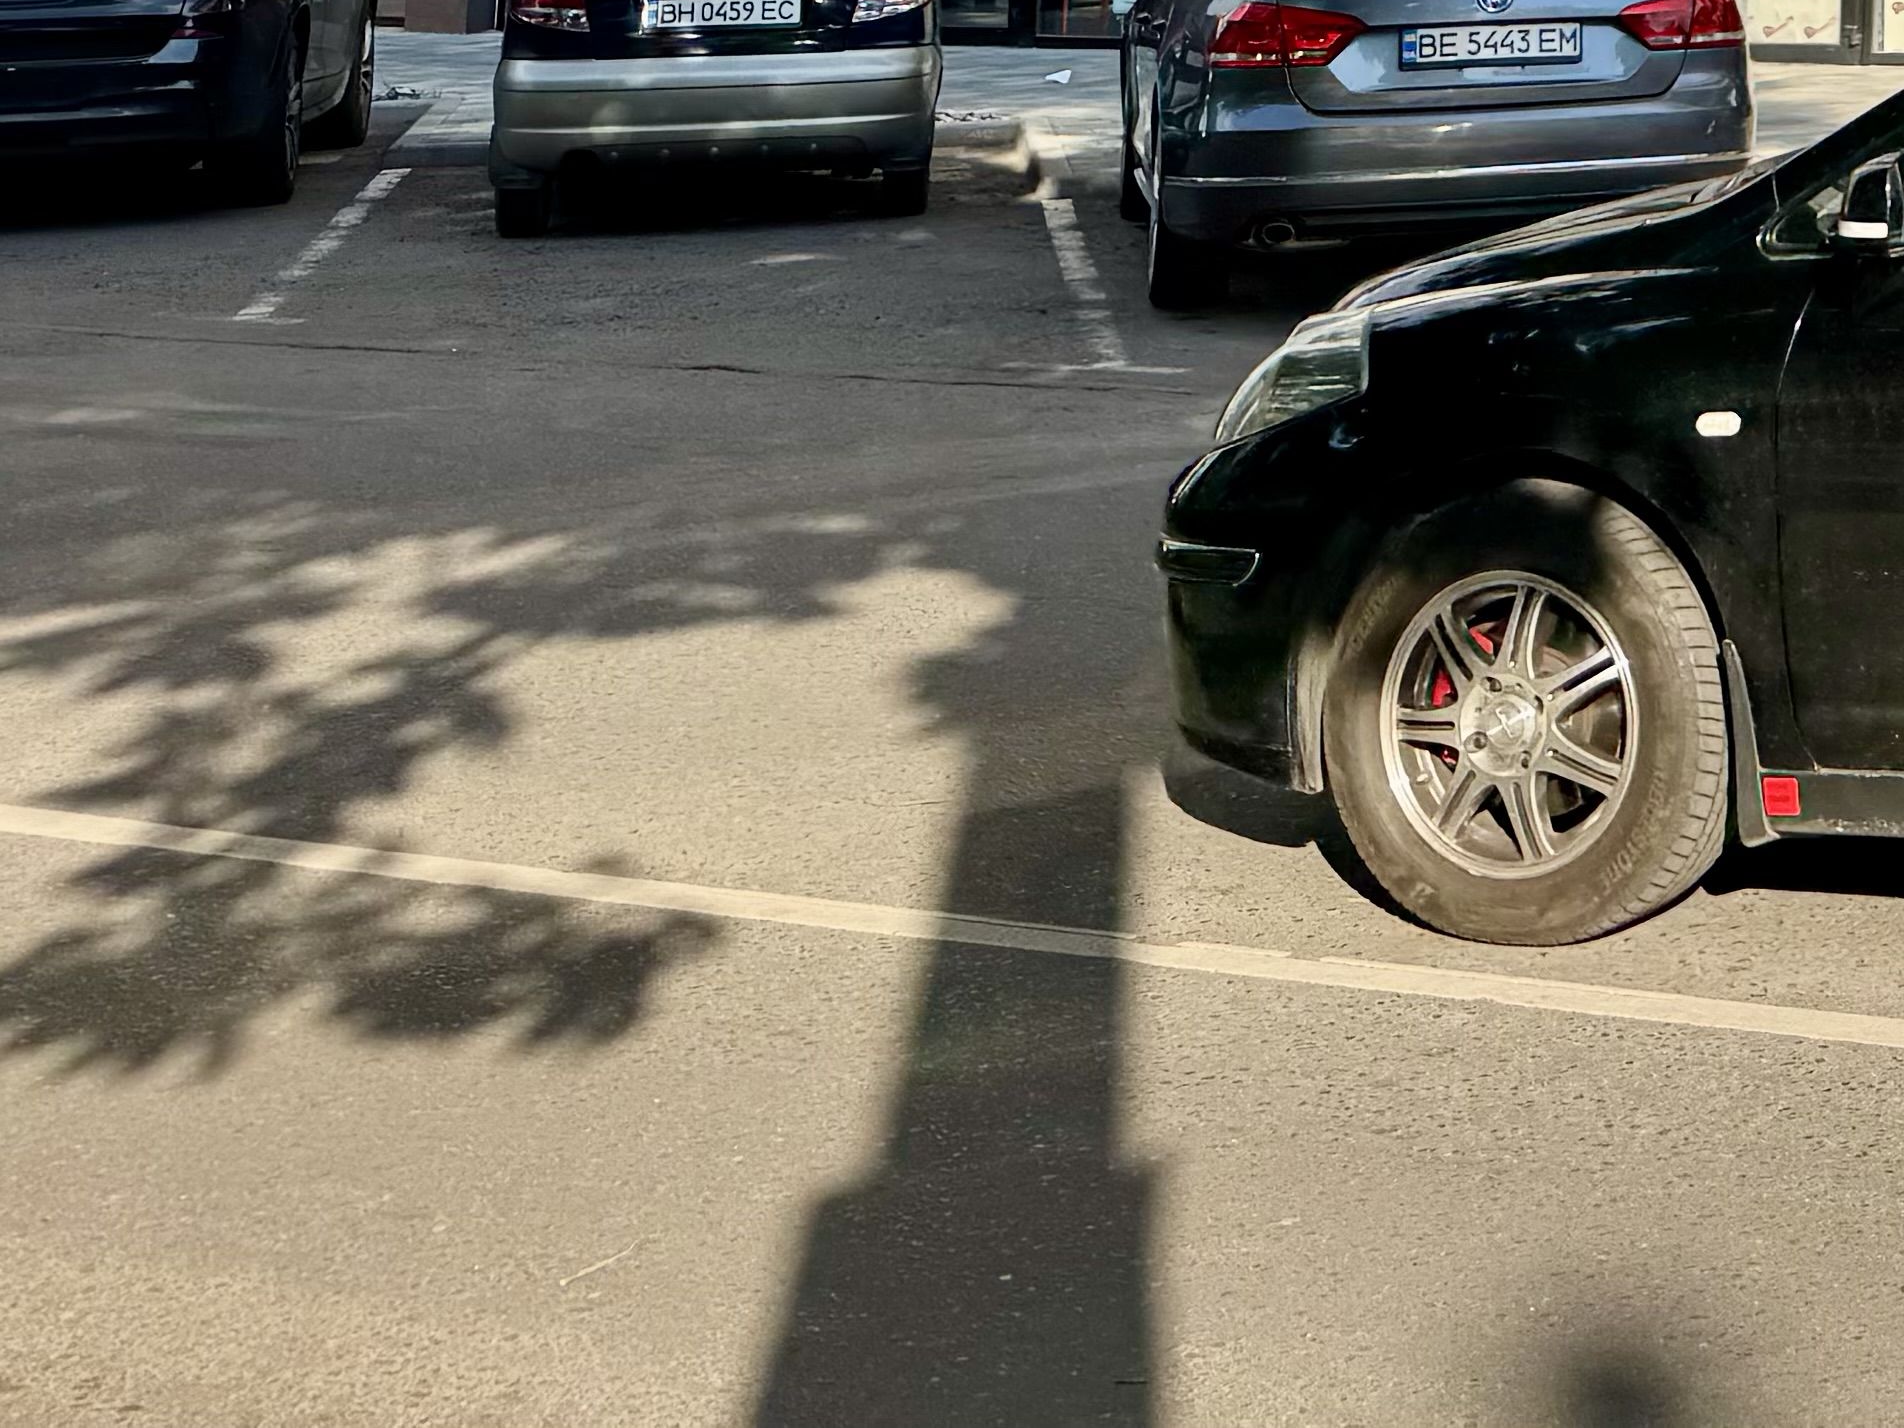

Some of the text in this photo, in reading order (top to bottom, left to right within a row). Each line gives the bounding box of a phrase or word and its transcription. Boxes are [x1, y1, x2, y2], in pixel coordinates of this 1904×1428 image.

[660, 0, 794, 24] BH 0459 EC
[1418, 27, 1578, 59] BE 5443 EM
